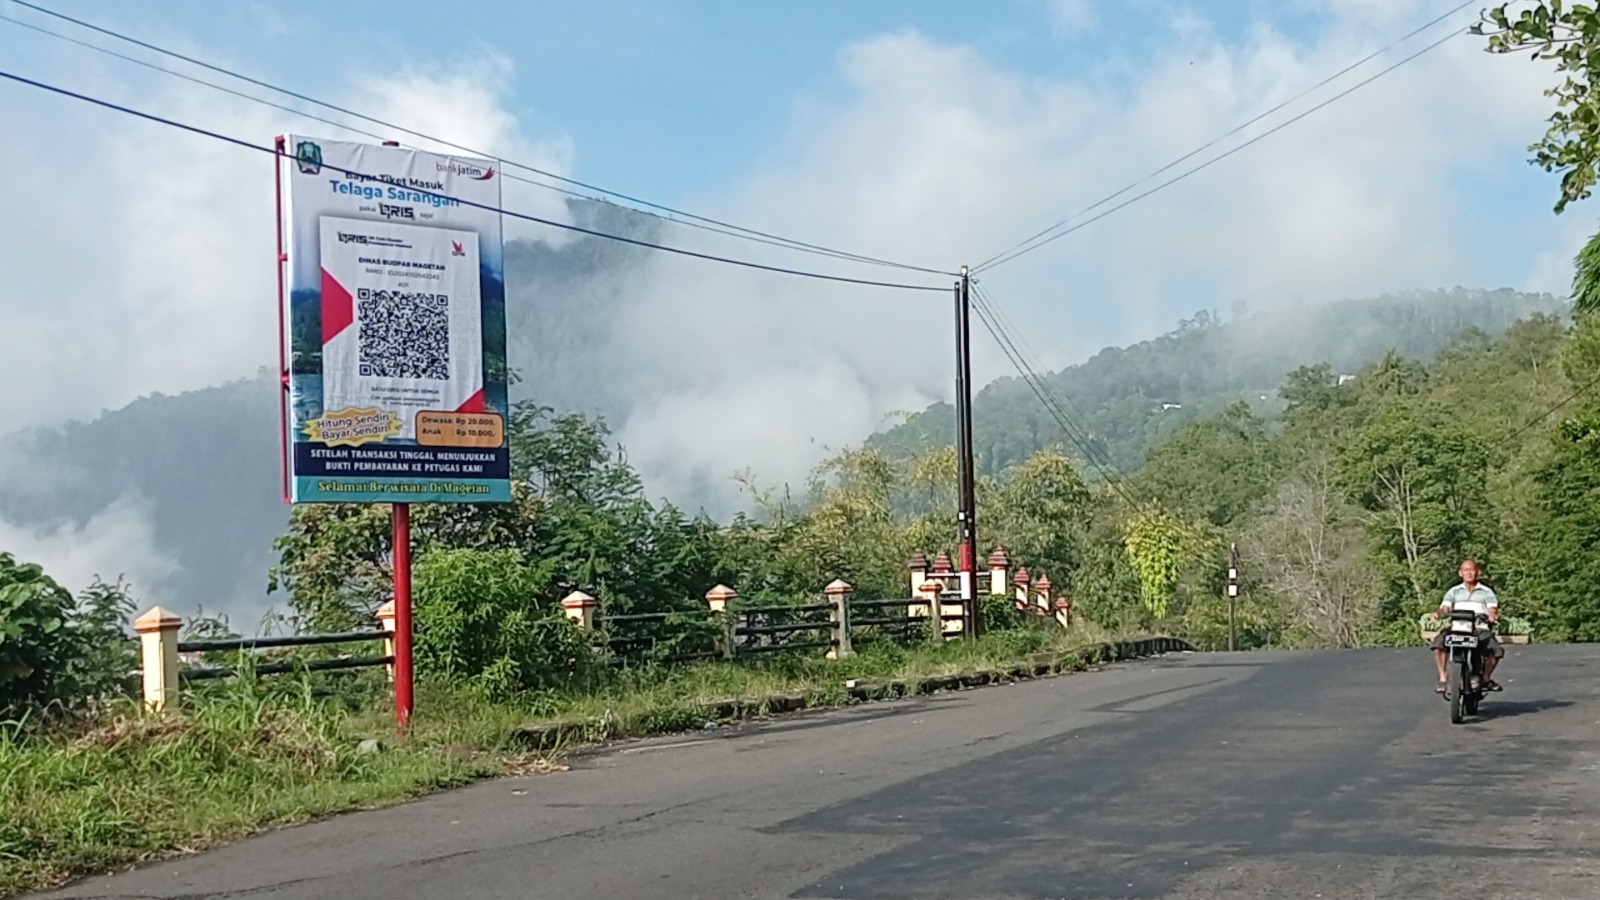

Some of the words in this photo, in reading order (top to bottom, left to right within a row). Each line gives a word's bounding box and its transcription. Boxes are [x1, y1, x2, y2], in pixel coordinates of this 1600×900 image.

[379, 173, 407, 186] Tiket
[409, 178, 444, 191] Masuk
[329, 180, 383, 200] Telaga
[387, 187, 460, 207] Sarangan
[379, 203, 414, 219] QRIS
[337, 231, 368, 245] QRIS
[358, 257, 381, 265] DINAS
[412, 262, 446, 271] MAGETAN
[317, 419, 352, 429] Hitung
[355, 413, 390, 424] Sendiri
[456, 417, 466, 426] Rp
[322, 430, 350, 440] Bayar
[353, 425, 388, 436] Sendiri
[456, 429, 467, 437] Rp
[311, 449, 348, 459] SETELAH
[351, 450, 397, 459] TRANSAKSI
[400, 451, 434, 460] TINGGAL
[437, 452, 496, 462] MENUNJUKKAN
[325, 461, 350, 471] BUKTI
[354, 462, 409, 471] PEMBAYARAN
[411, 463, 422, 471] KE
[424, 463, 460, 472] PETUGAS
[462, 464, 484, 473] KAMI
[318, 481, 367, 492] Selamat
[369, 481, 427, 492] Berwisata
[429, 482, 441, 493] Di
[443, 482, 490, 496] Magetan
